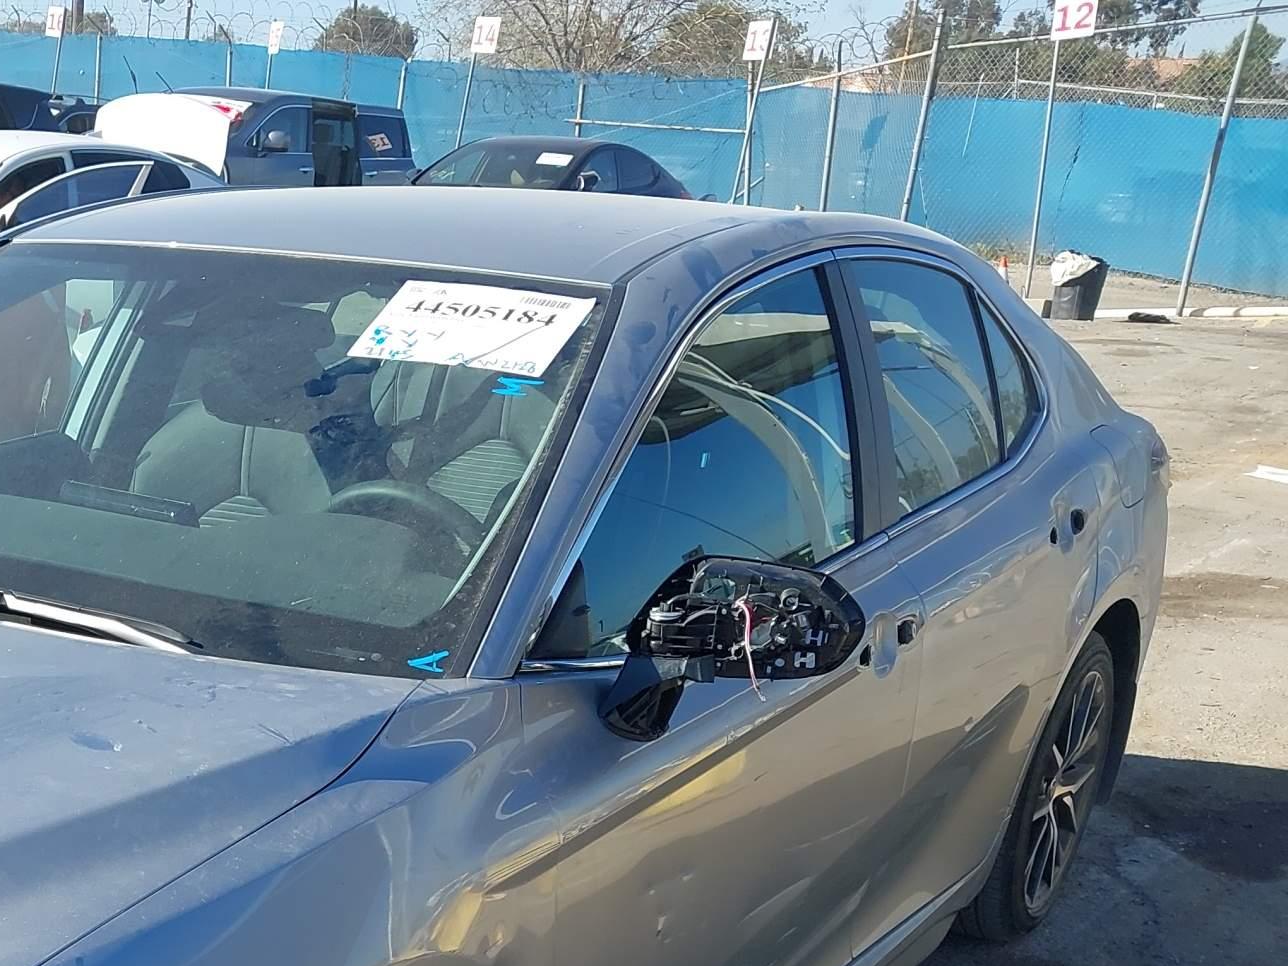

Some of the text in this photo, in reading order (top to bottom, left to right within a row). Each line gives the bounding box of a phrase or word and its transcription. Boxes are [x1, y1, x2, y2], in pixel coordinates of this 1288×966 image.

[1055, 2, 1094, 32] 12
[474, 24, 496, 46] 14
[405, 300, 558, 327] 44505184
